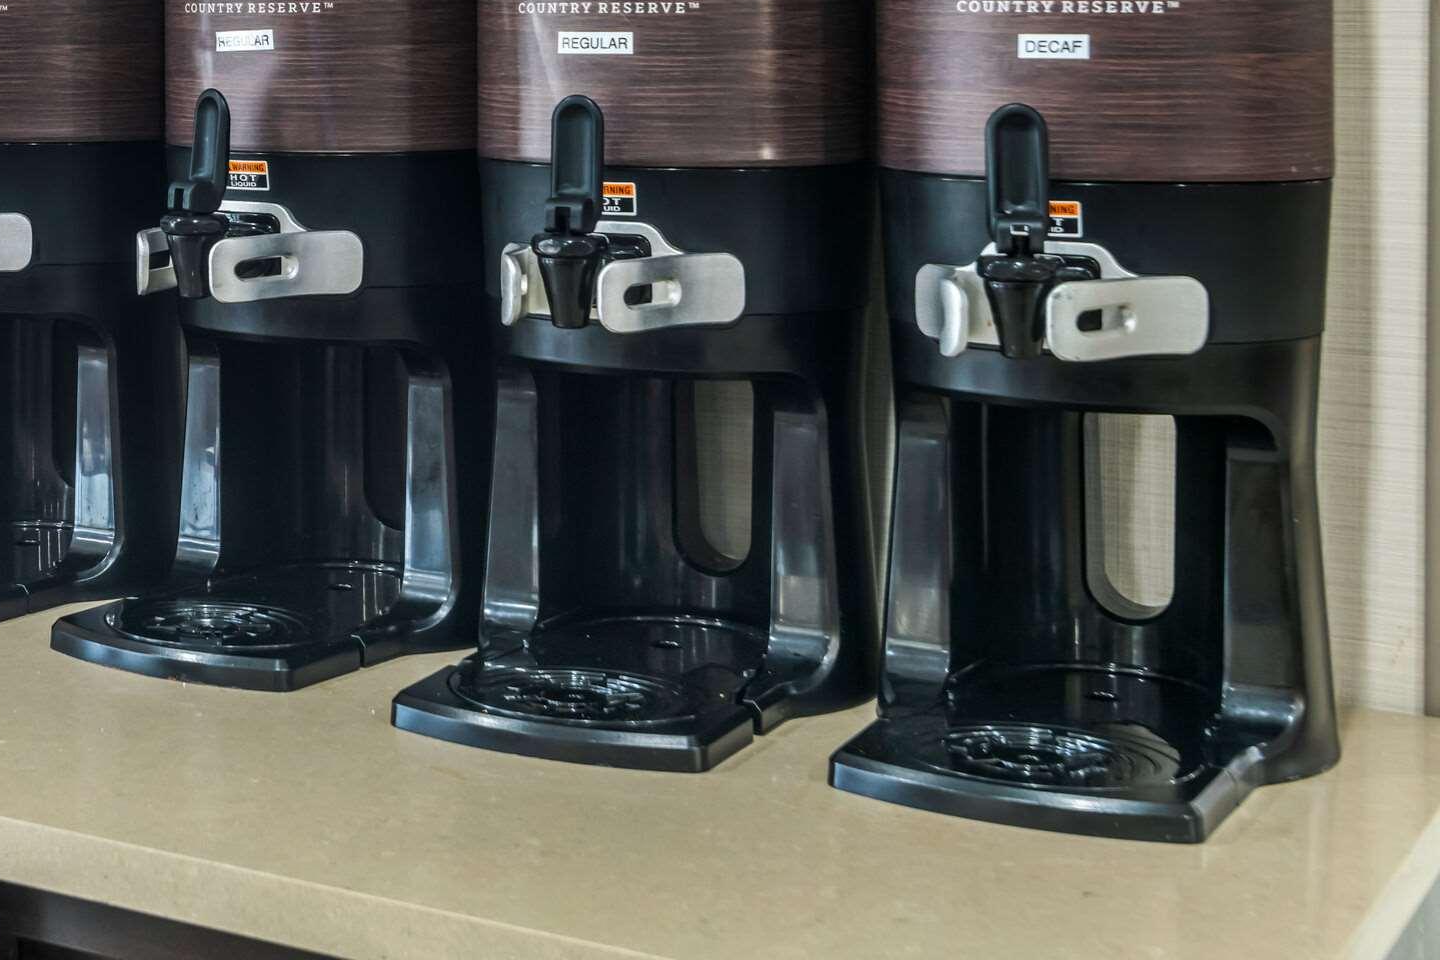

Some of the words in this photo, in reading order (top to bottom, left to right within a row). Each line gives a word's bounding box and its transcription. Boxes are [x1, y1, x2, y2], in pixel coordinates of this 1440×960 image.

[184, 2, 243, 14] COUNTRY
[518, 2, 591, 14] COUNTRY
[956, 0, 1054, 13] COUNTRY
[562, 37, 628, 49] REGULAR
[1025, 40, 1083, 54] DECAF
[230, 174, 257, 182] HOT
[603, 185, 632, 194] RNING
[602, 197, 621, 206] OT
